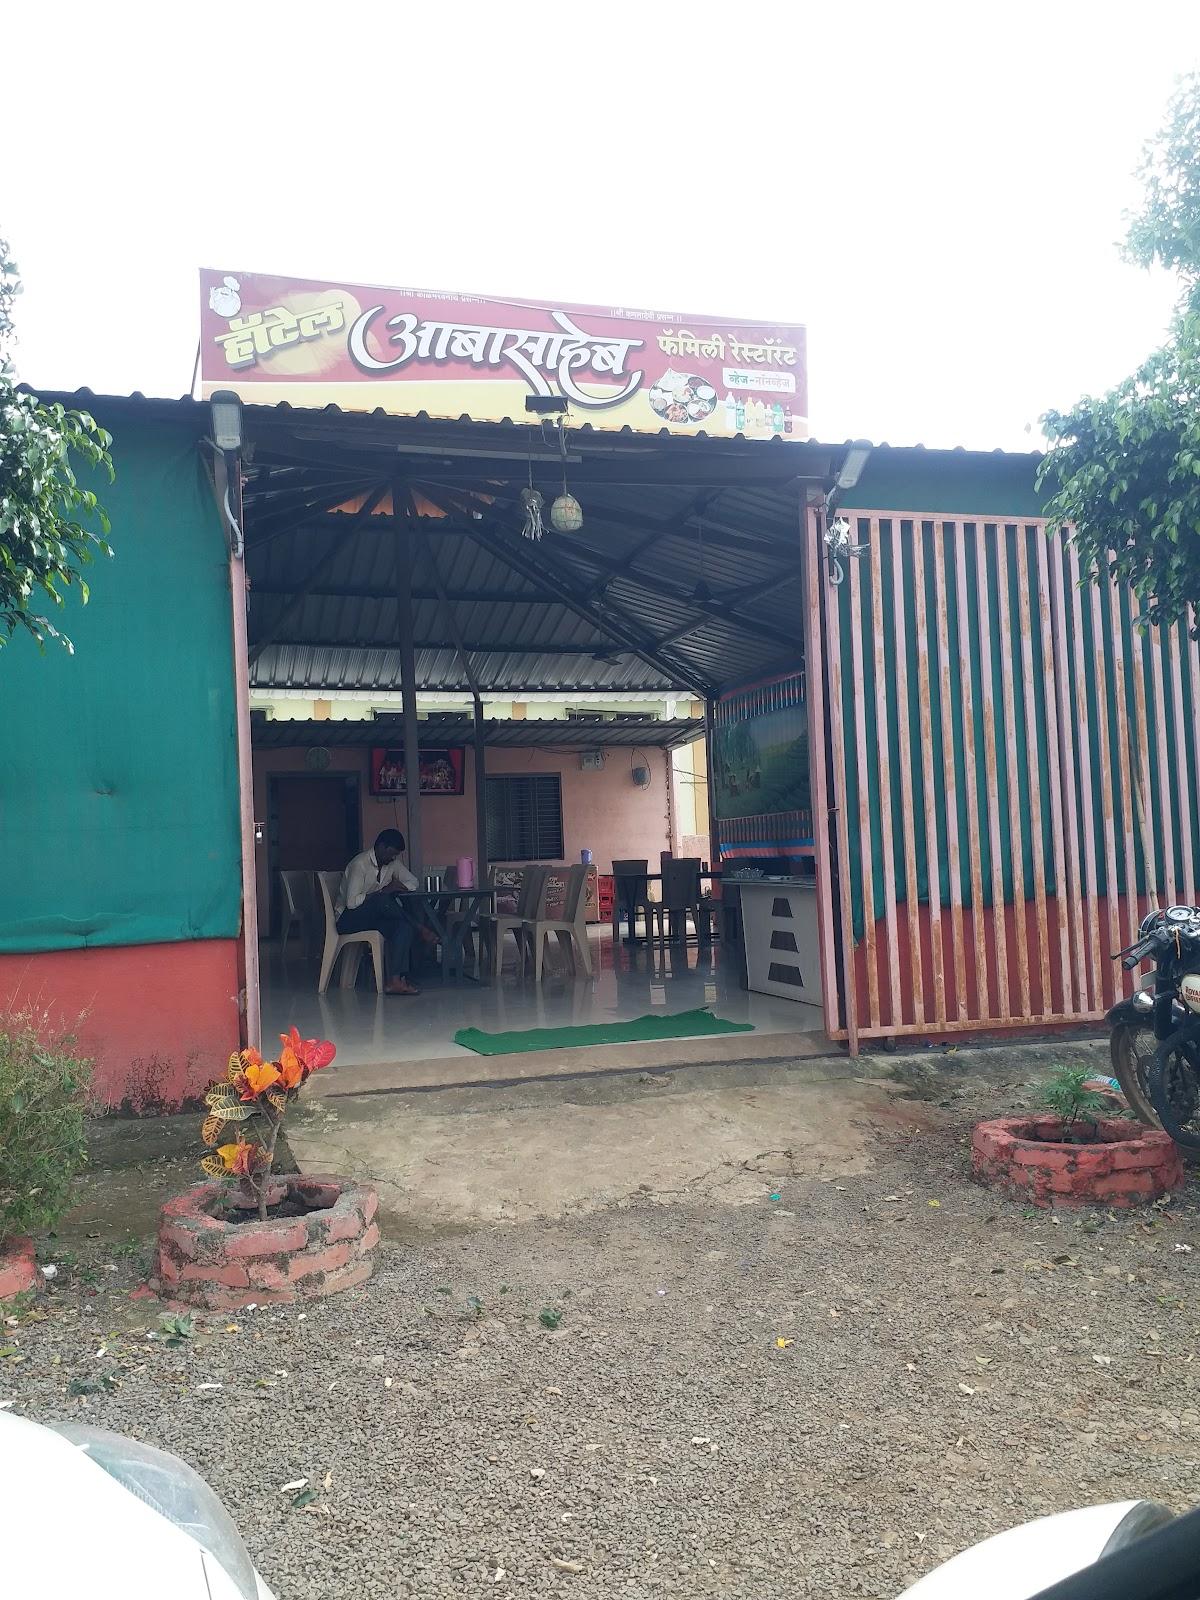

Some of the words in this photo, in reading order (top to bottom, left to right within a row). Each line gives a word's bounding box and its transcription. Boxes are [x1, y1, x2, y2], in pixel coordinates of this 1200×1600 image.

[214, 302, 346, 366] हॉटेल
[350, 305, 643, 407] आबासाहेब
[656, 327, 726, 361] फॅमिली
[729, 334, 798, 367] रेस्टॉरंट
